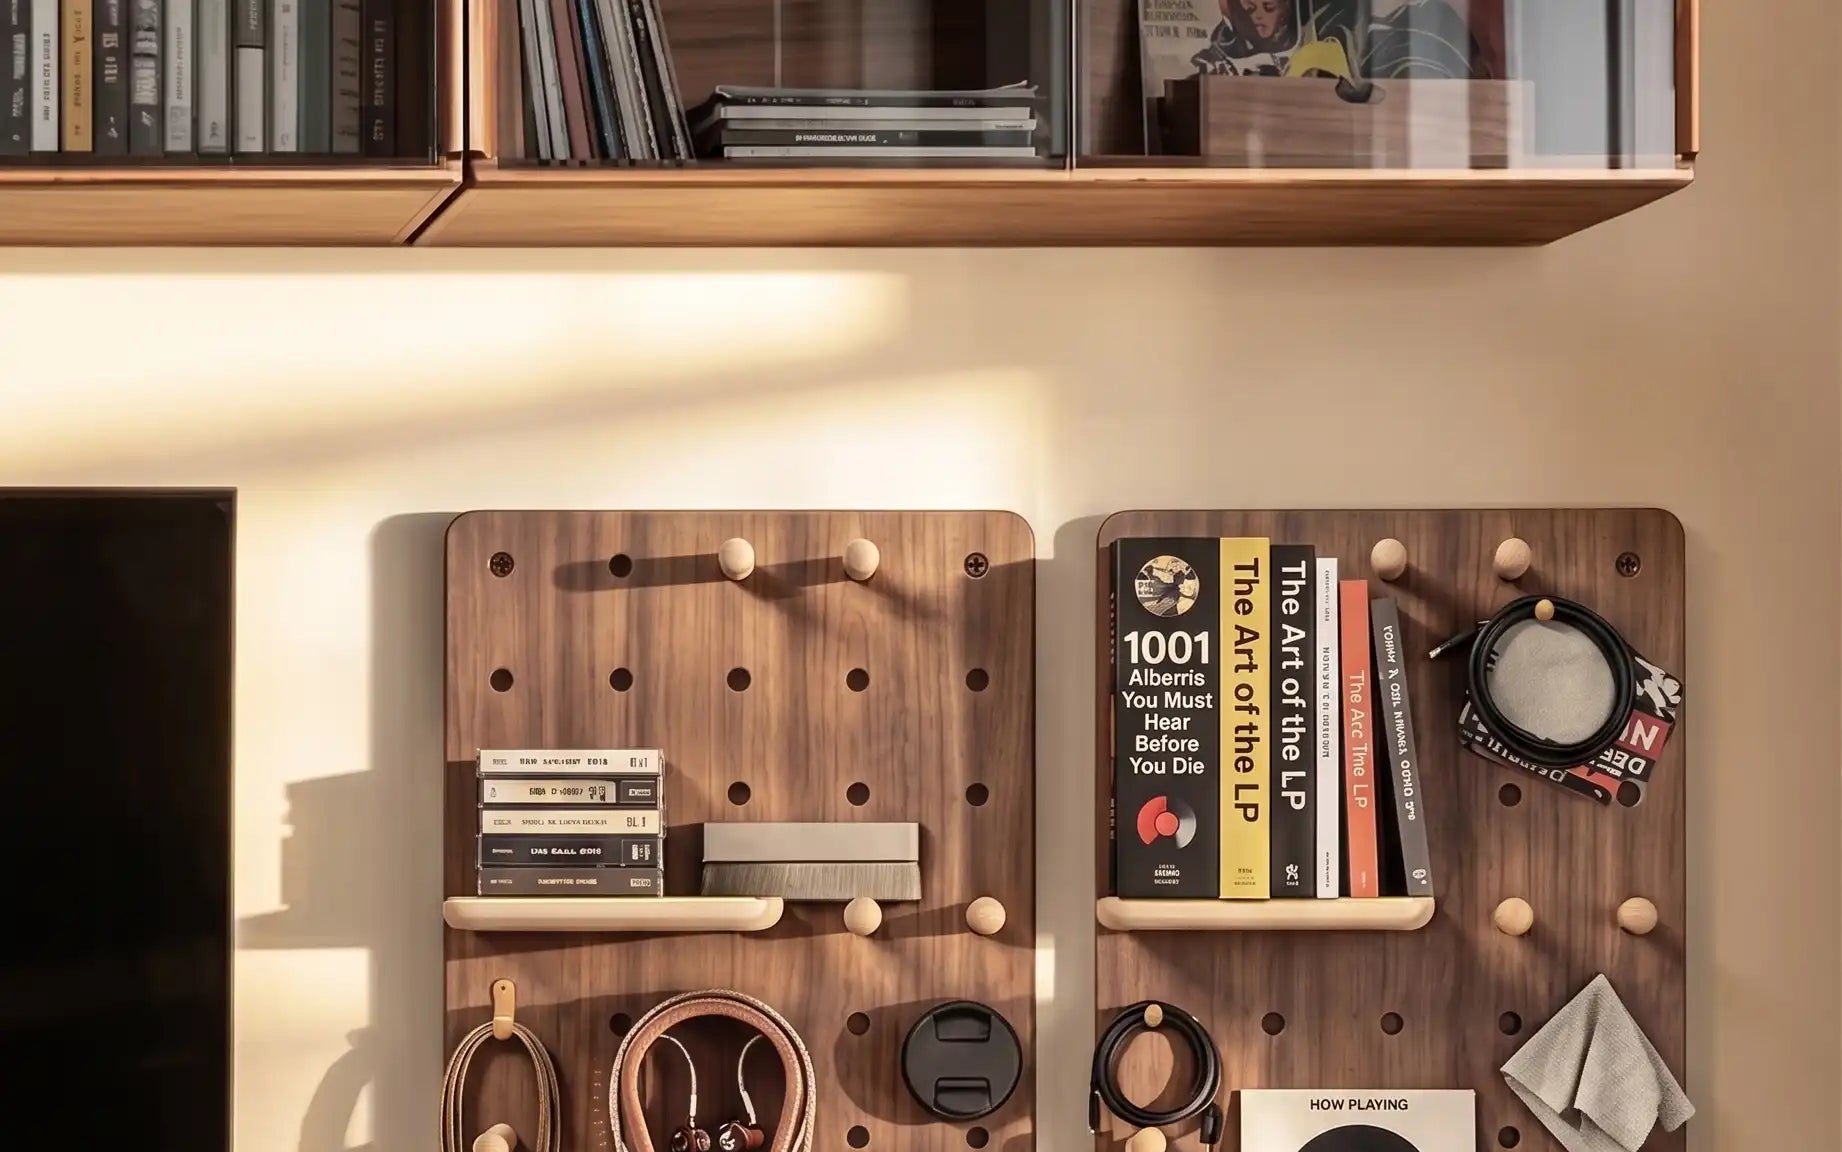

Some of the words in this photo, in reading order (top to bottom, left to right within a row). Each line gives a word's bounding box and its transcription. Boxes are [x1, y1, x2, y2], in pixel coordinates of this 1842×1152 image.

[1233, 557, 1260, 616] The
[1281, 560, 1306, 615] The
[1123, 630, 1209, 665] 1001
[1234, 624, 1260, 674] Art
[1281, 623, 1306, 670] Art
[1128, 668, 1206, 687] Alberris
[1349, 669, 1365, 704] The
[1121, 690, 1161, 709] You
[1164, 691, 1213, 709] Must
[1234, 682, 1260, 716] of
[1281, 677, 1307, 714] of
[1144, 713, 1191, 731] Hear
[1281, 717, 1307, 761] the
[1135, 734, 1200, 753] Before
[1233, 722, 1261, 774] the
[1129, 756, 1169, 775] You
[1172, 756, 1205, 775] Die
[1234, 783, 1260, 823] LP
[1281, 770, 1307, 810] LP
[1353, 784, 1369, 808] LP
[1310, 1098, 1345, 1111] HOW
[1348, 1098, 1409, 1111] PLAYING
